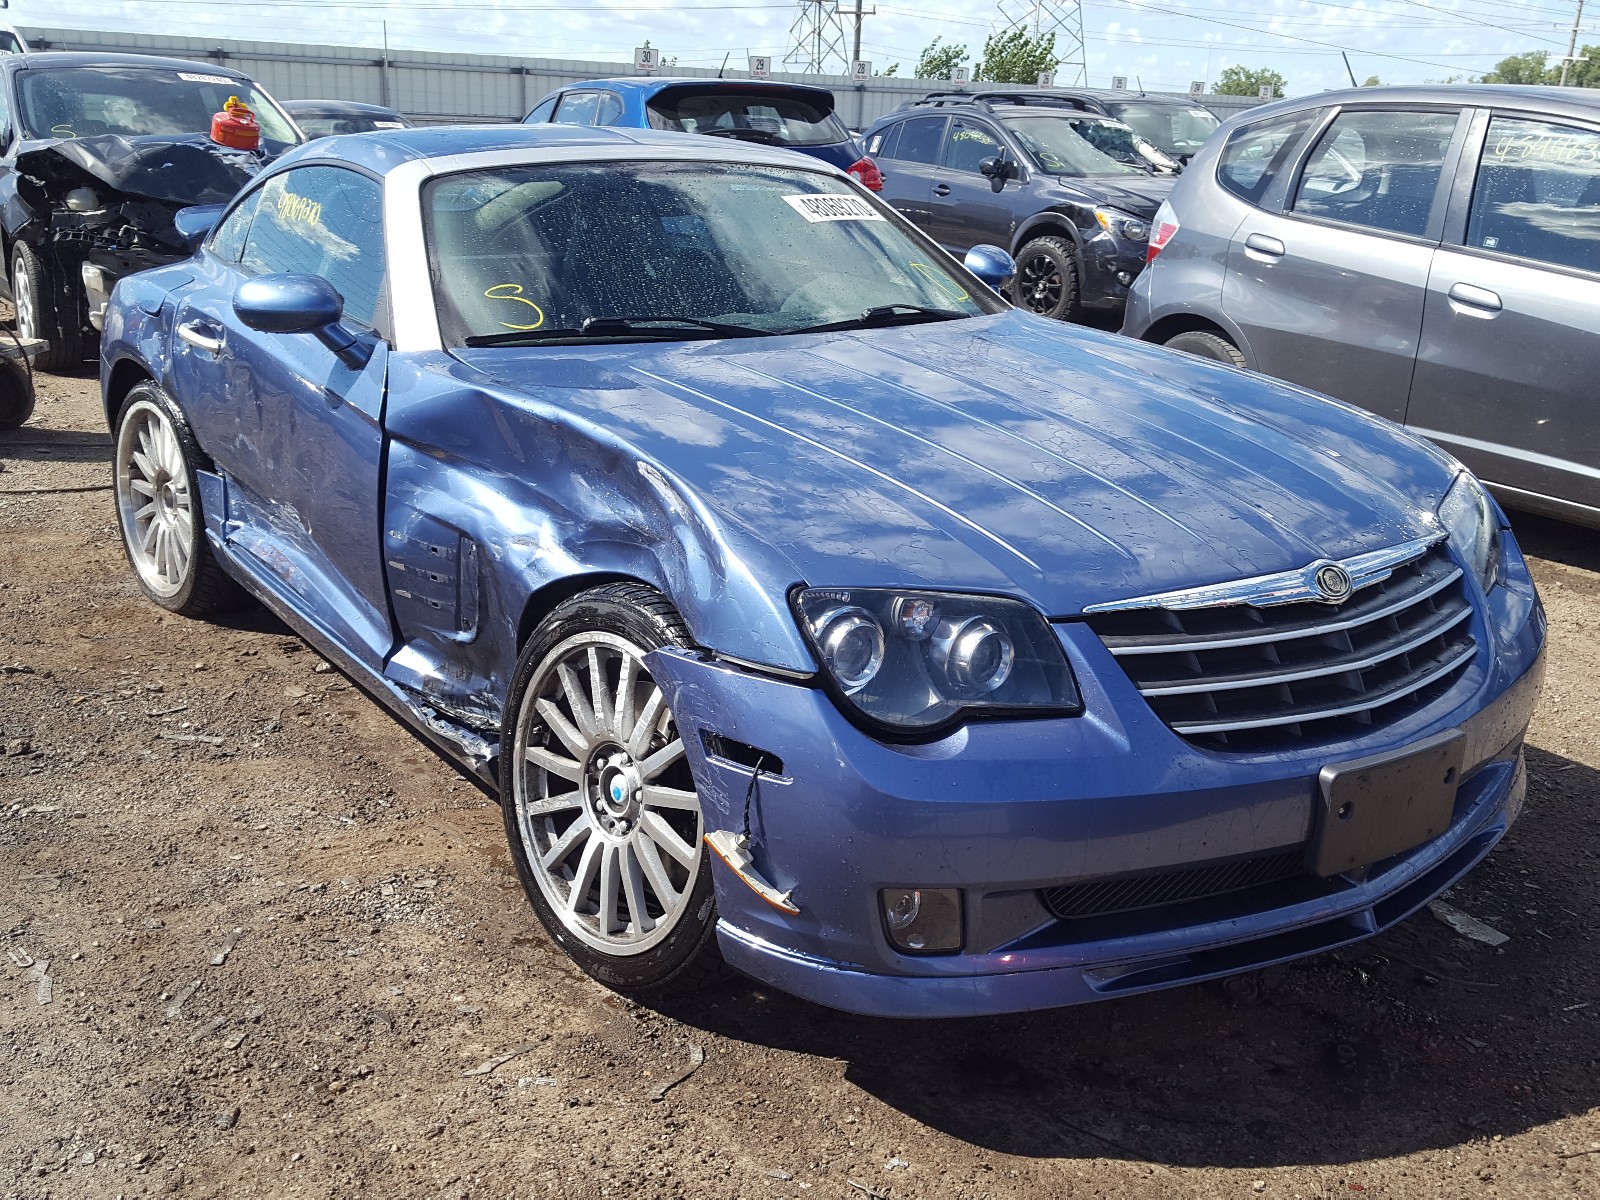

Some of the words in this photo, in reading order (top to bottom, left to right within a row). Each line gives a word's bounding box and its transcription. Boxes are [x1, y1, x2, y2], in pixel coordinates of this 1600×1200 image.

[642, 50, 651, 63] 30
[755, 58, 764, 70] 29
[857, 63, 866, 74] 28
[956, 69, 964, 80] 27
[800, 197, 874, 217] 48069270
[484, 284, 544, 330] S
